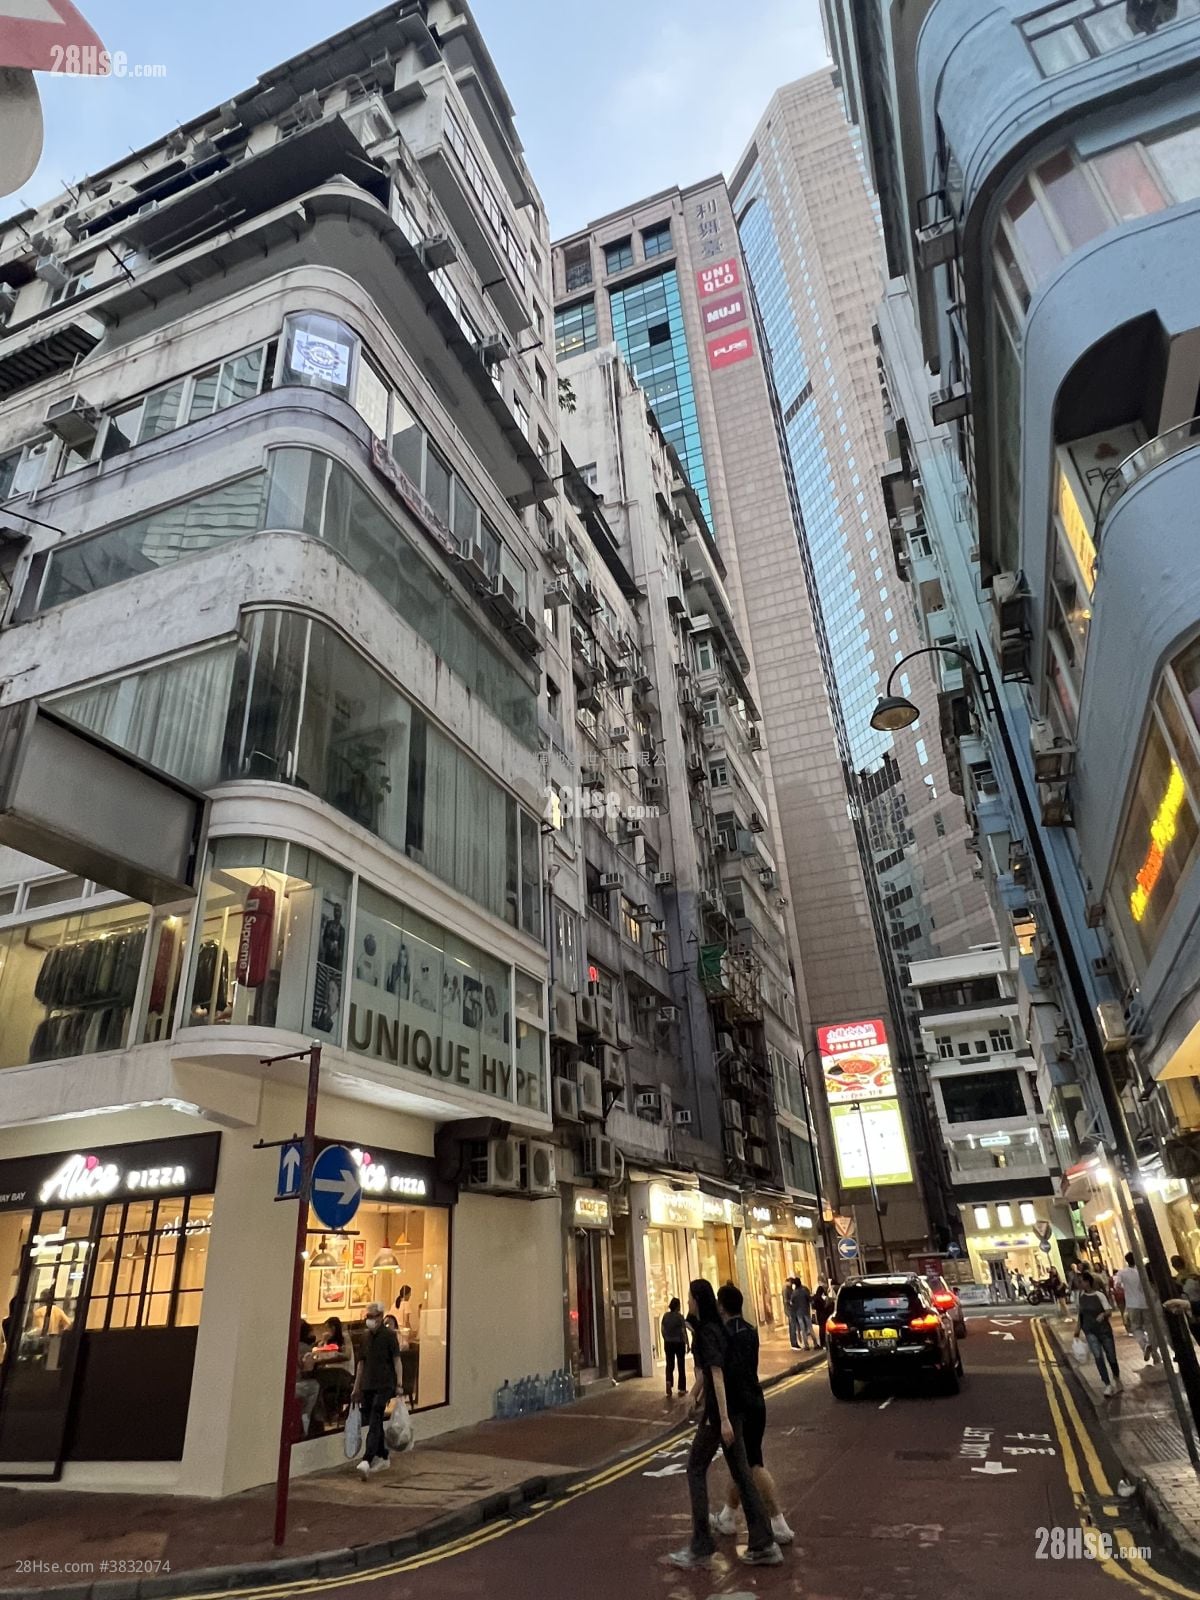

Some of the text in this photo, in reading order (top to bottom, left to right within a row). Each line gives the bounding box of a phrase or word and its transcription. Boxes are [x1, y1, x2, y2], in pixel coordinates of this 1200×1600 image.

[702, 263, 730, 282] UNI
[704, 273, 734, 292] QLO
[707, 301, 741, 323] MUJI
[238, 915, 256, 971] Supreme
[348, 1002, 538, 1109] UNIQUE HYPE
[39, 1154, 186, 1203] Alice PIZZA
[390, 1175, 426, 1195] PIZZA
[11, 1191, 26, 1201] BAY
